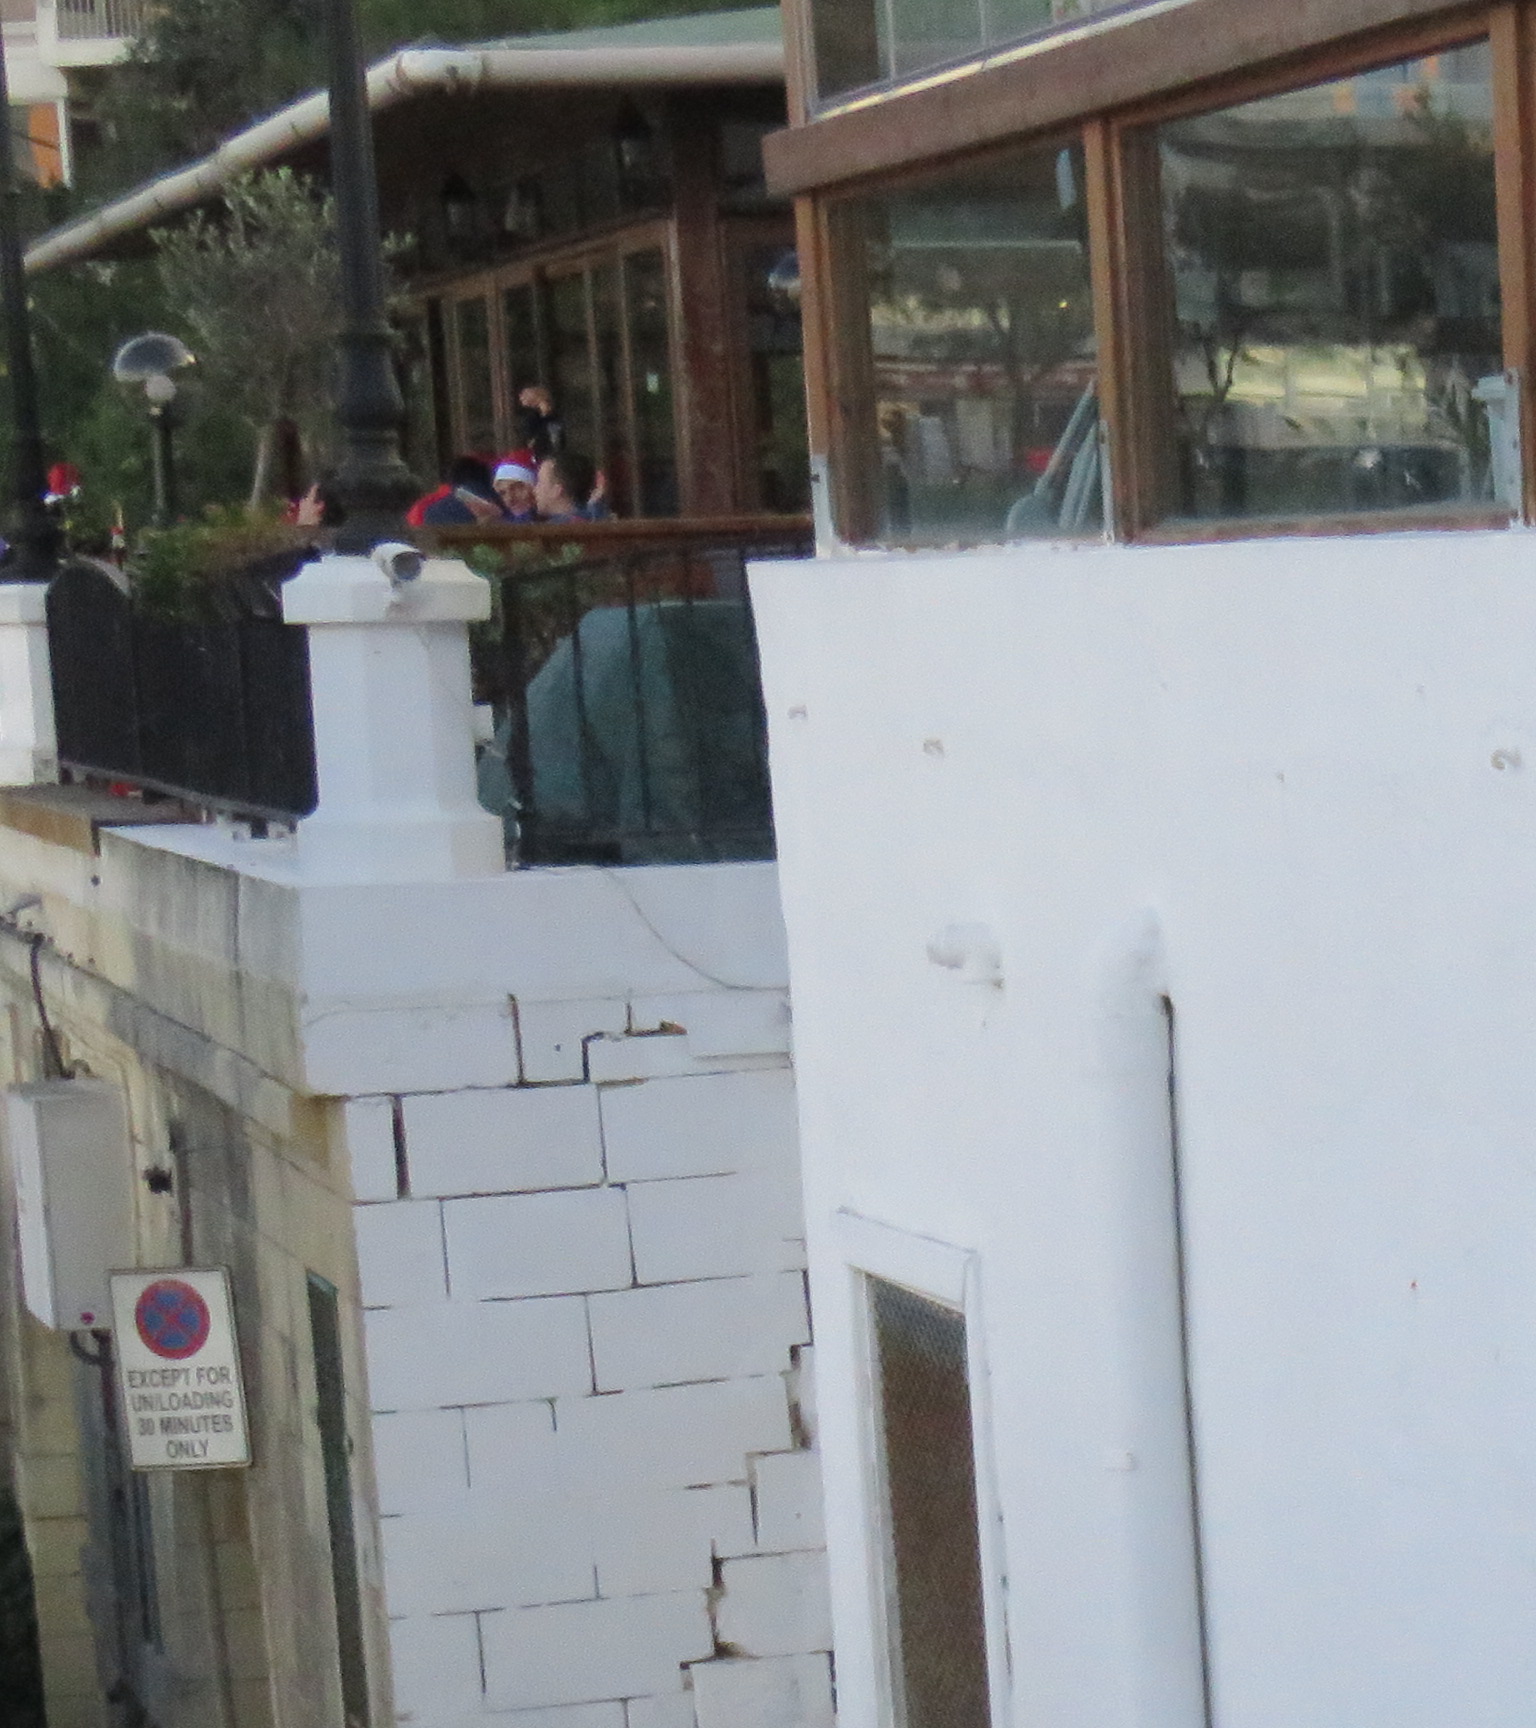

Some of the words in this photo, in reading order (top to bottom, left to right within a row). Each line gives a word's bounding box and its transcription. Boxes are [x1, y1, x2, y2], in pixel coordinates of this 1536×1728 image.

[127, 1367, 190, 1389] EXCEPT
[196, 1365, 231, 1385] FOR
[159, 1414, 233, 1435] MINUTES
[166, 1439, 209, 1459] ONLY
